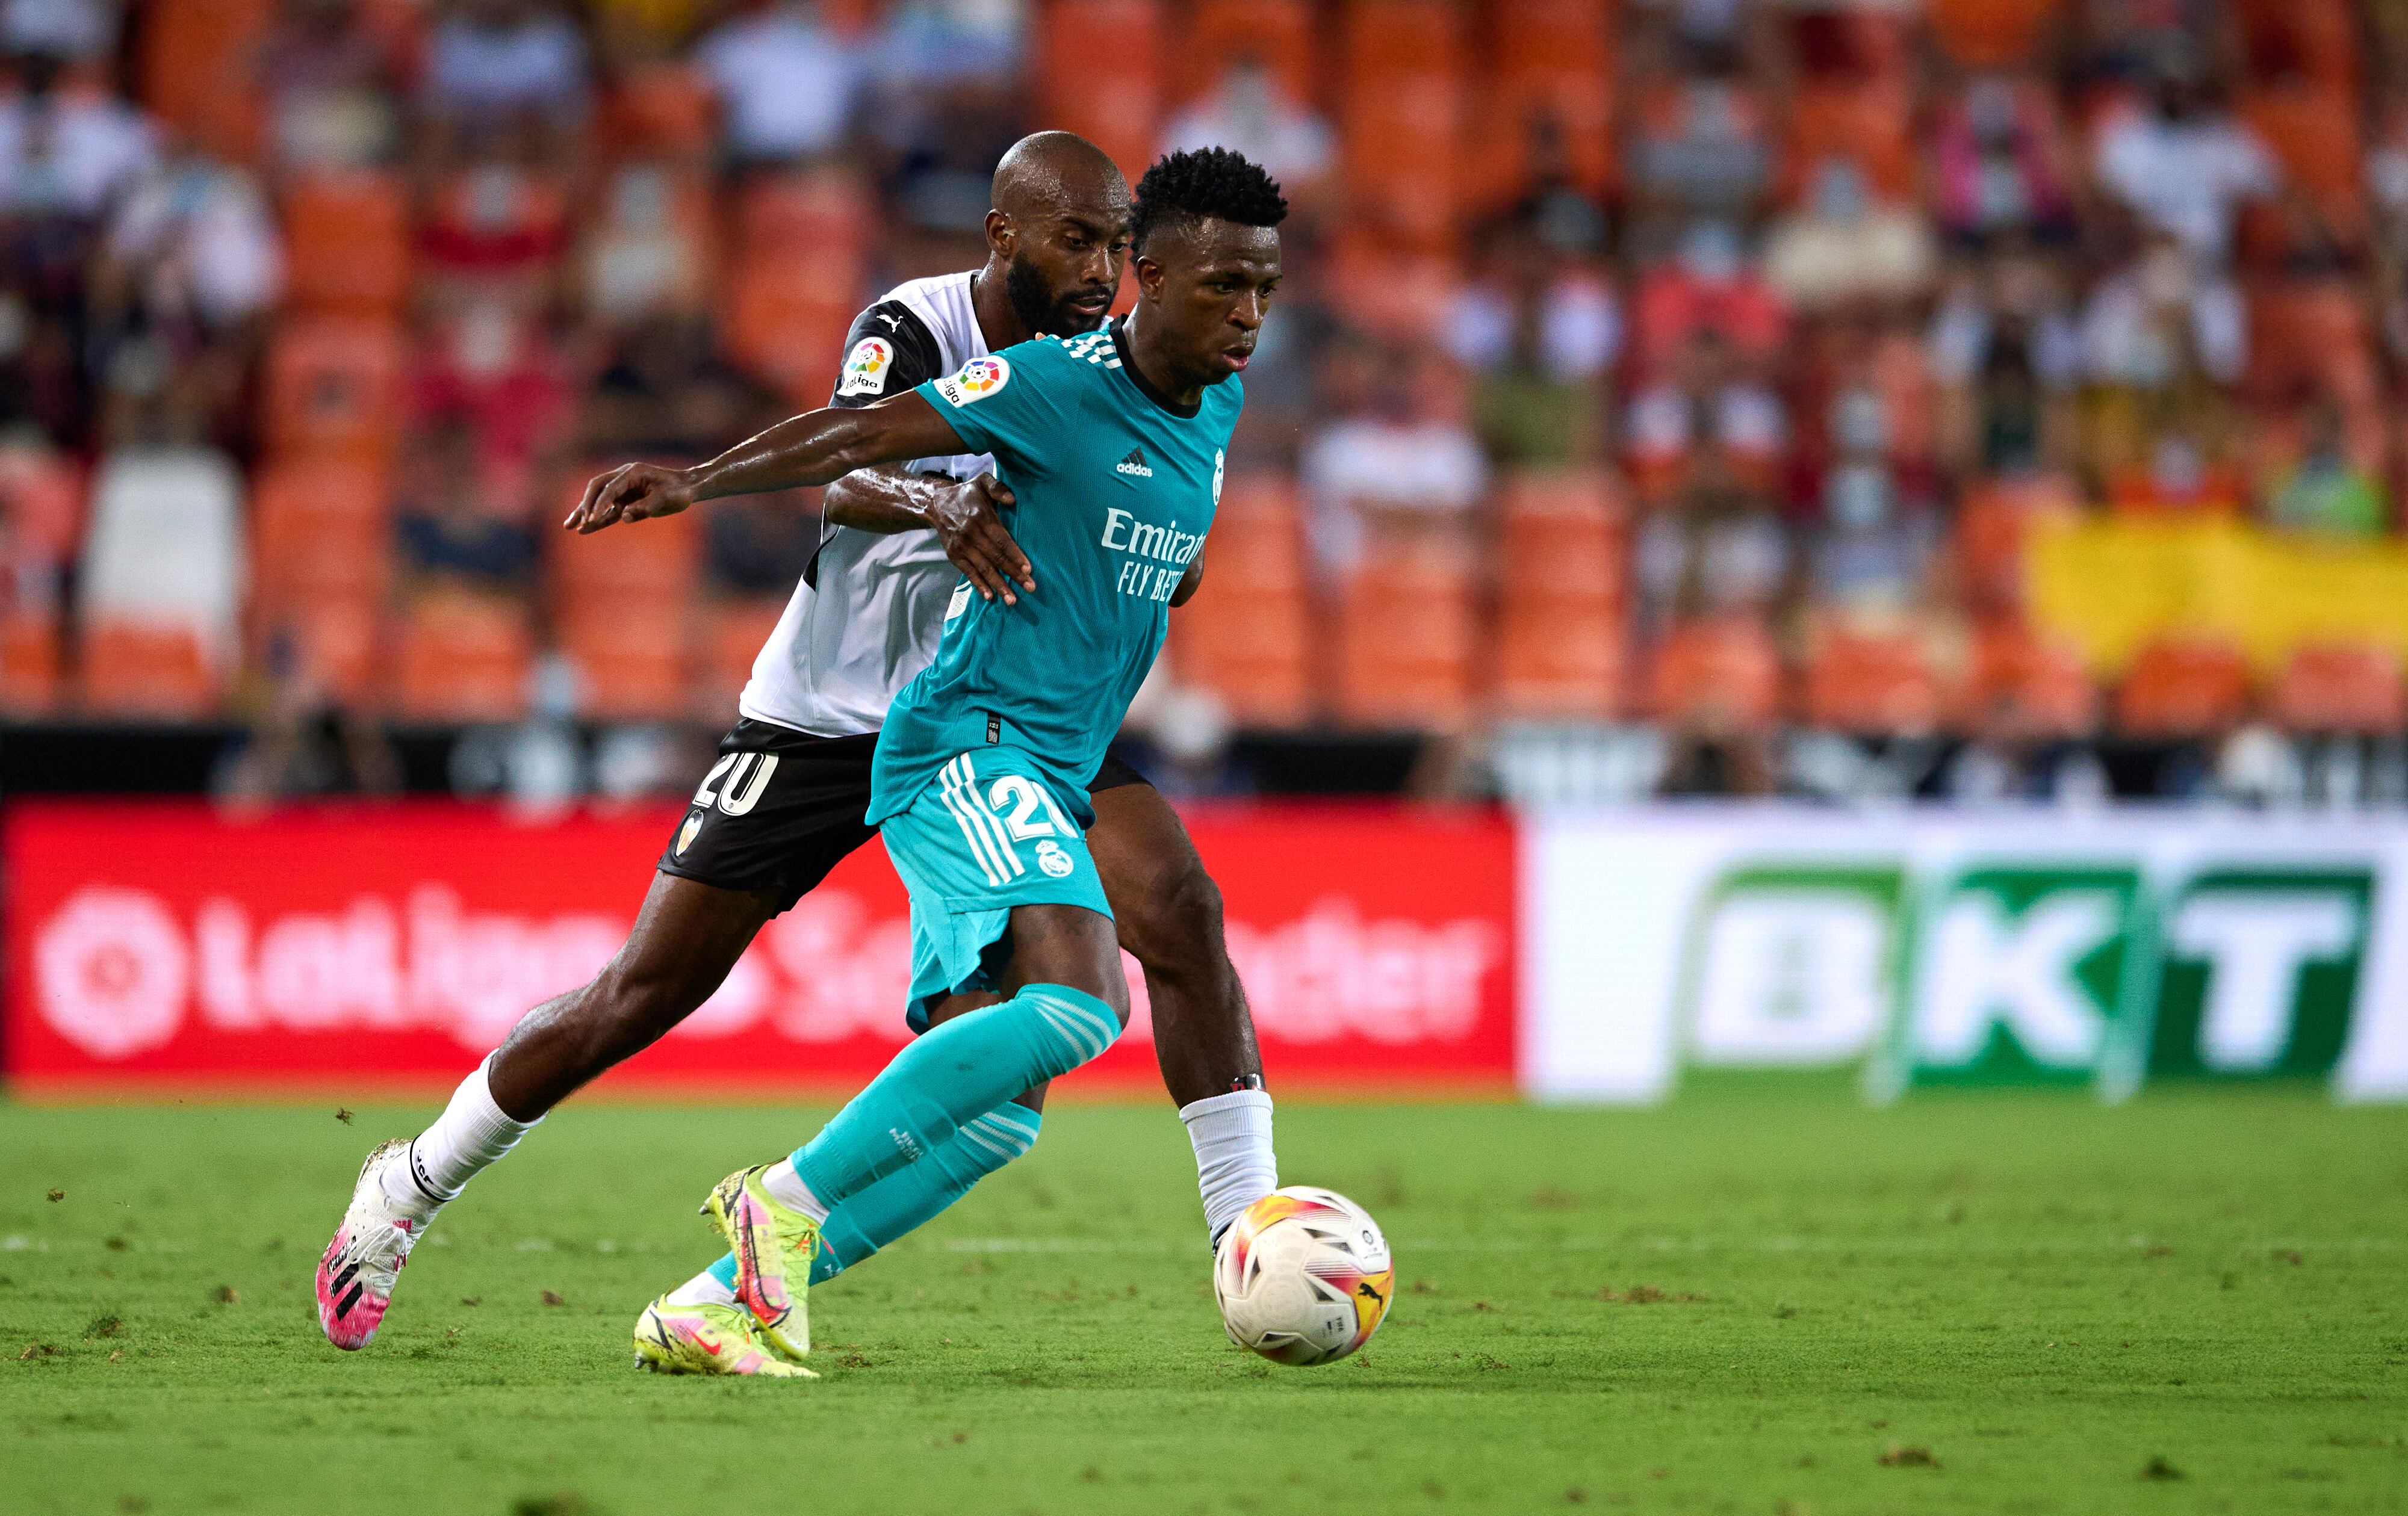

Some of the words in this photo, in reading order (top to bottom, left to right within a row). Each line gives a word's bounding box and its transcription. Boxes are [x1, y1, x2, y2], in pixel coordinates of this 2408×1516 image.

[1116, 462, 1153, 477] adidas
[1101, 507, 1206, 565] Emirat
[1117, 561, 1154, 597] FLY
[692, 752, 779, 816] 20
[1690, 888, 2357, 1071] BKT
